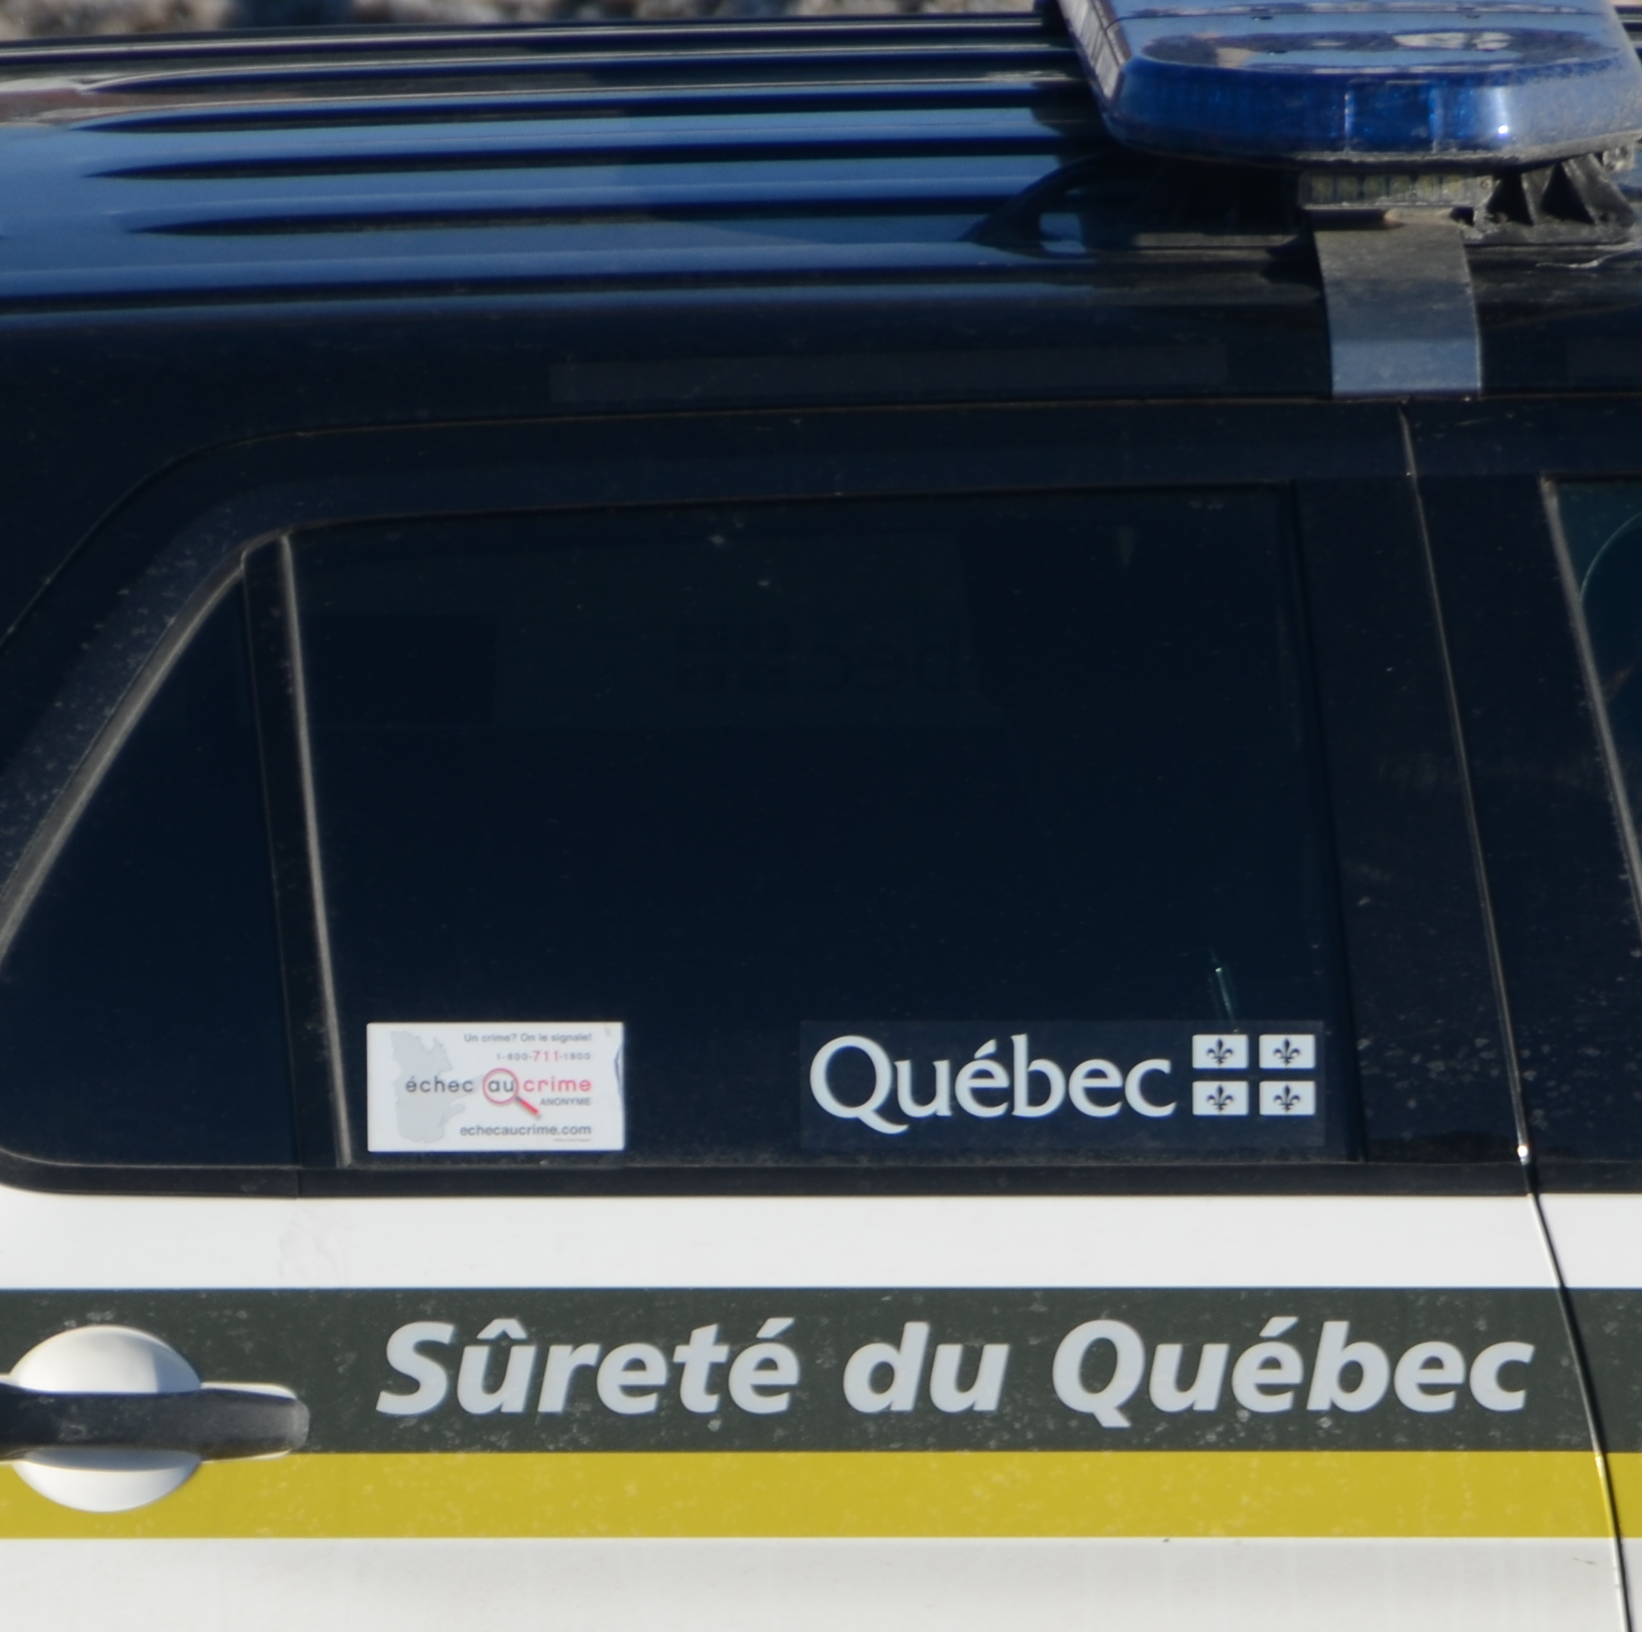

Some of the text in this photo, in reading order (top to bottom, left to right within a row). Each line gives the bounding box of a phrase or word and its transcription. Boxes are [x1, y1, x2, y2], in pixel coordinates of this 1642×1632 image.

[463, 1032, 593, 1045] Un crime? On le signale!
[495, 1050, 592, 1062] 1-800-711-1800
[405, 1075, 593, 1094] échec au crime
[809, 1032, 1177, 1136] Québec
[539, 1096, 592, 1107] ANONYME
[459, 1122, 593, 1137] echecaucrime.com
[375, 1315, 1535, 1429] Sûreté du Québec
